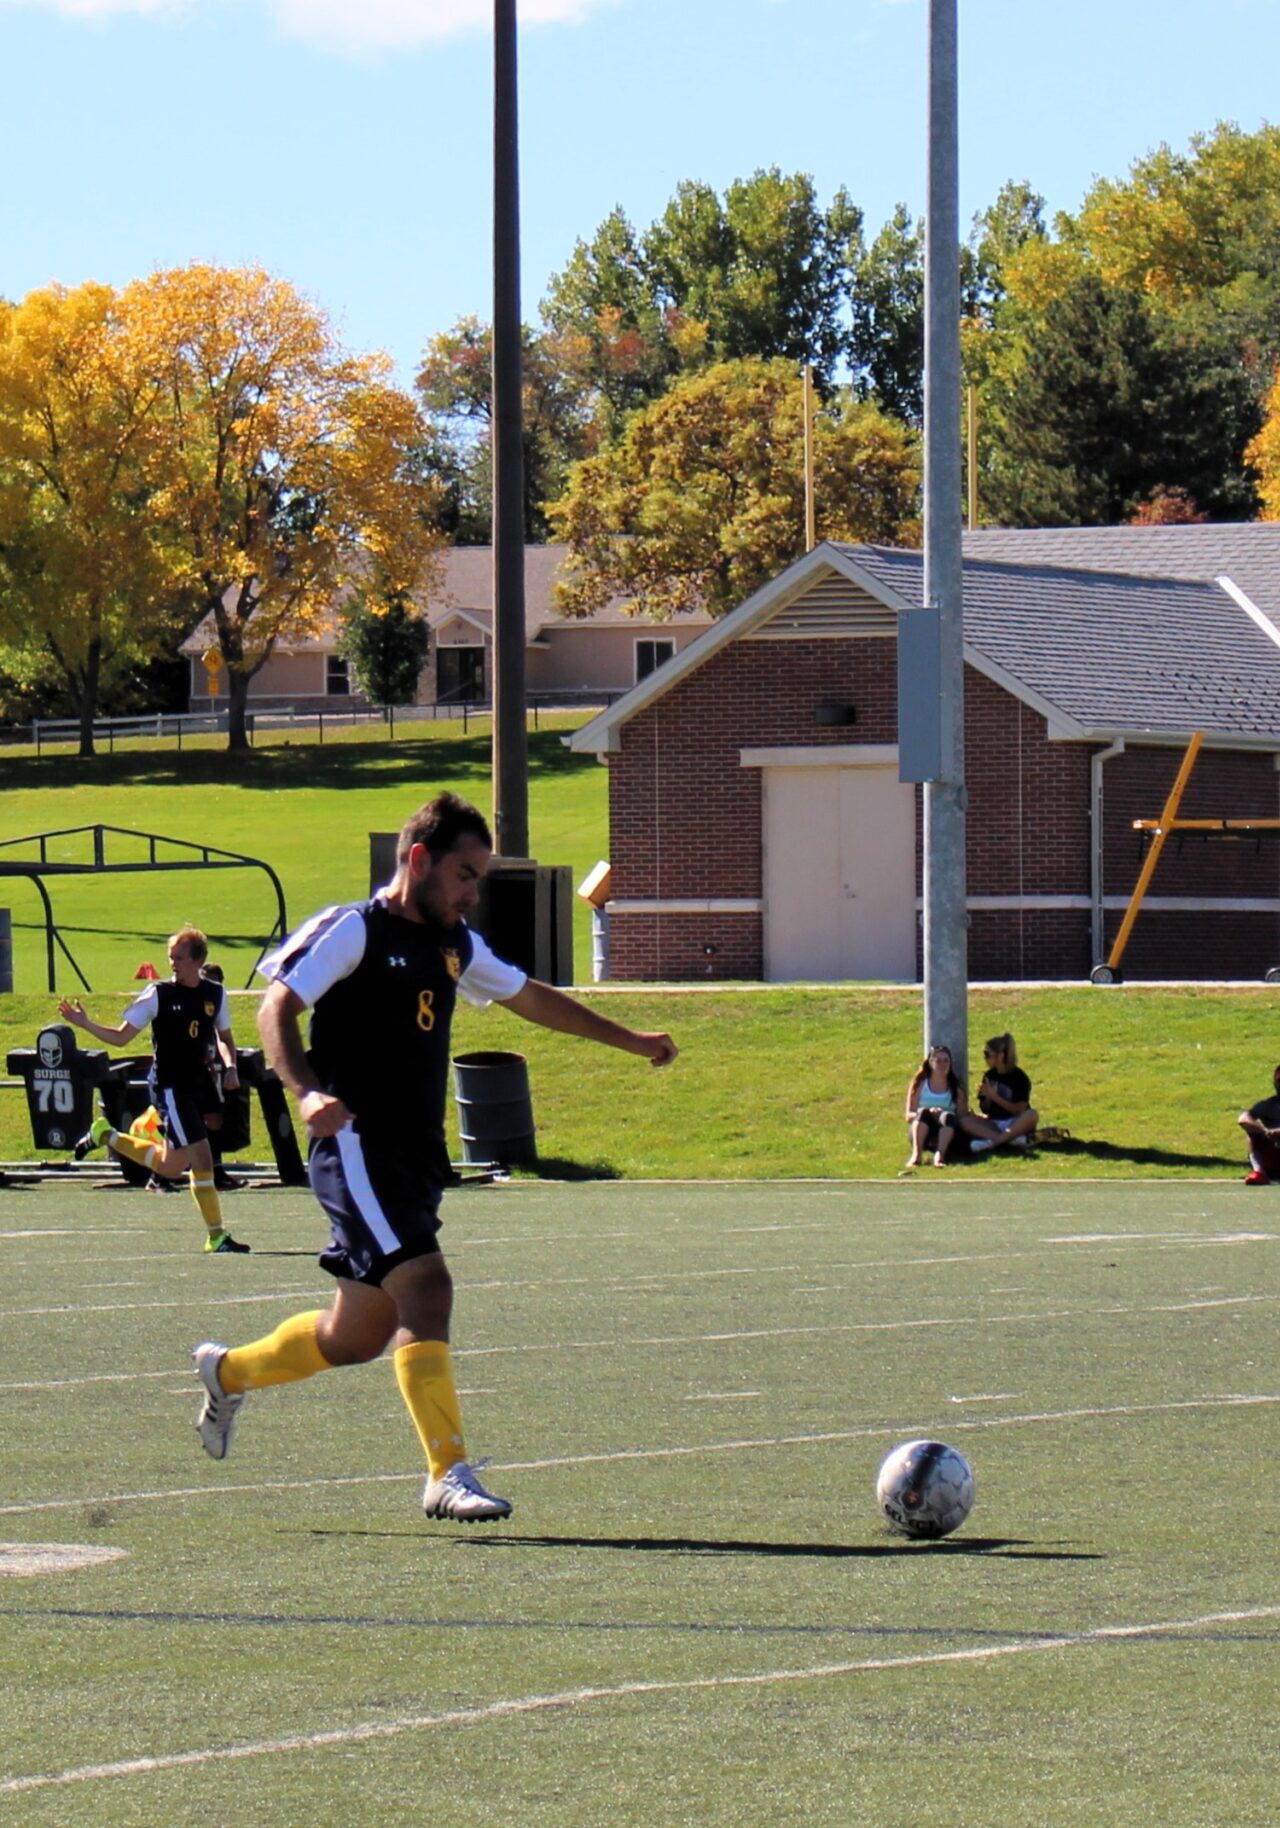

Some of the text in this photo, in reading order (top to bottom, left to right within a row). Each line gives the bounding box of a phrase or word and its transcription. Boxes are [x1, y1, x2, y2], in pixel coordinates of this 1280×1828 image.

[417, 989, 434, 1031] 8
[189, 1019, 199, 1038] 6
[34, 1069, 71, 1079] SURGE
[33, 1080, 74, 1113] 70
